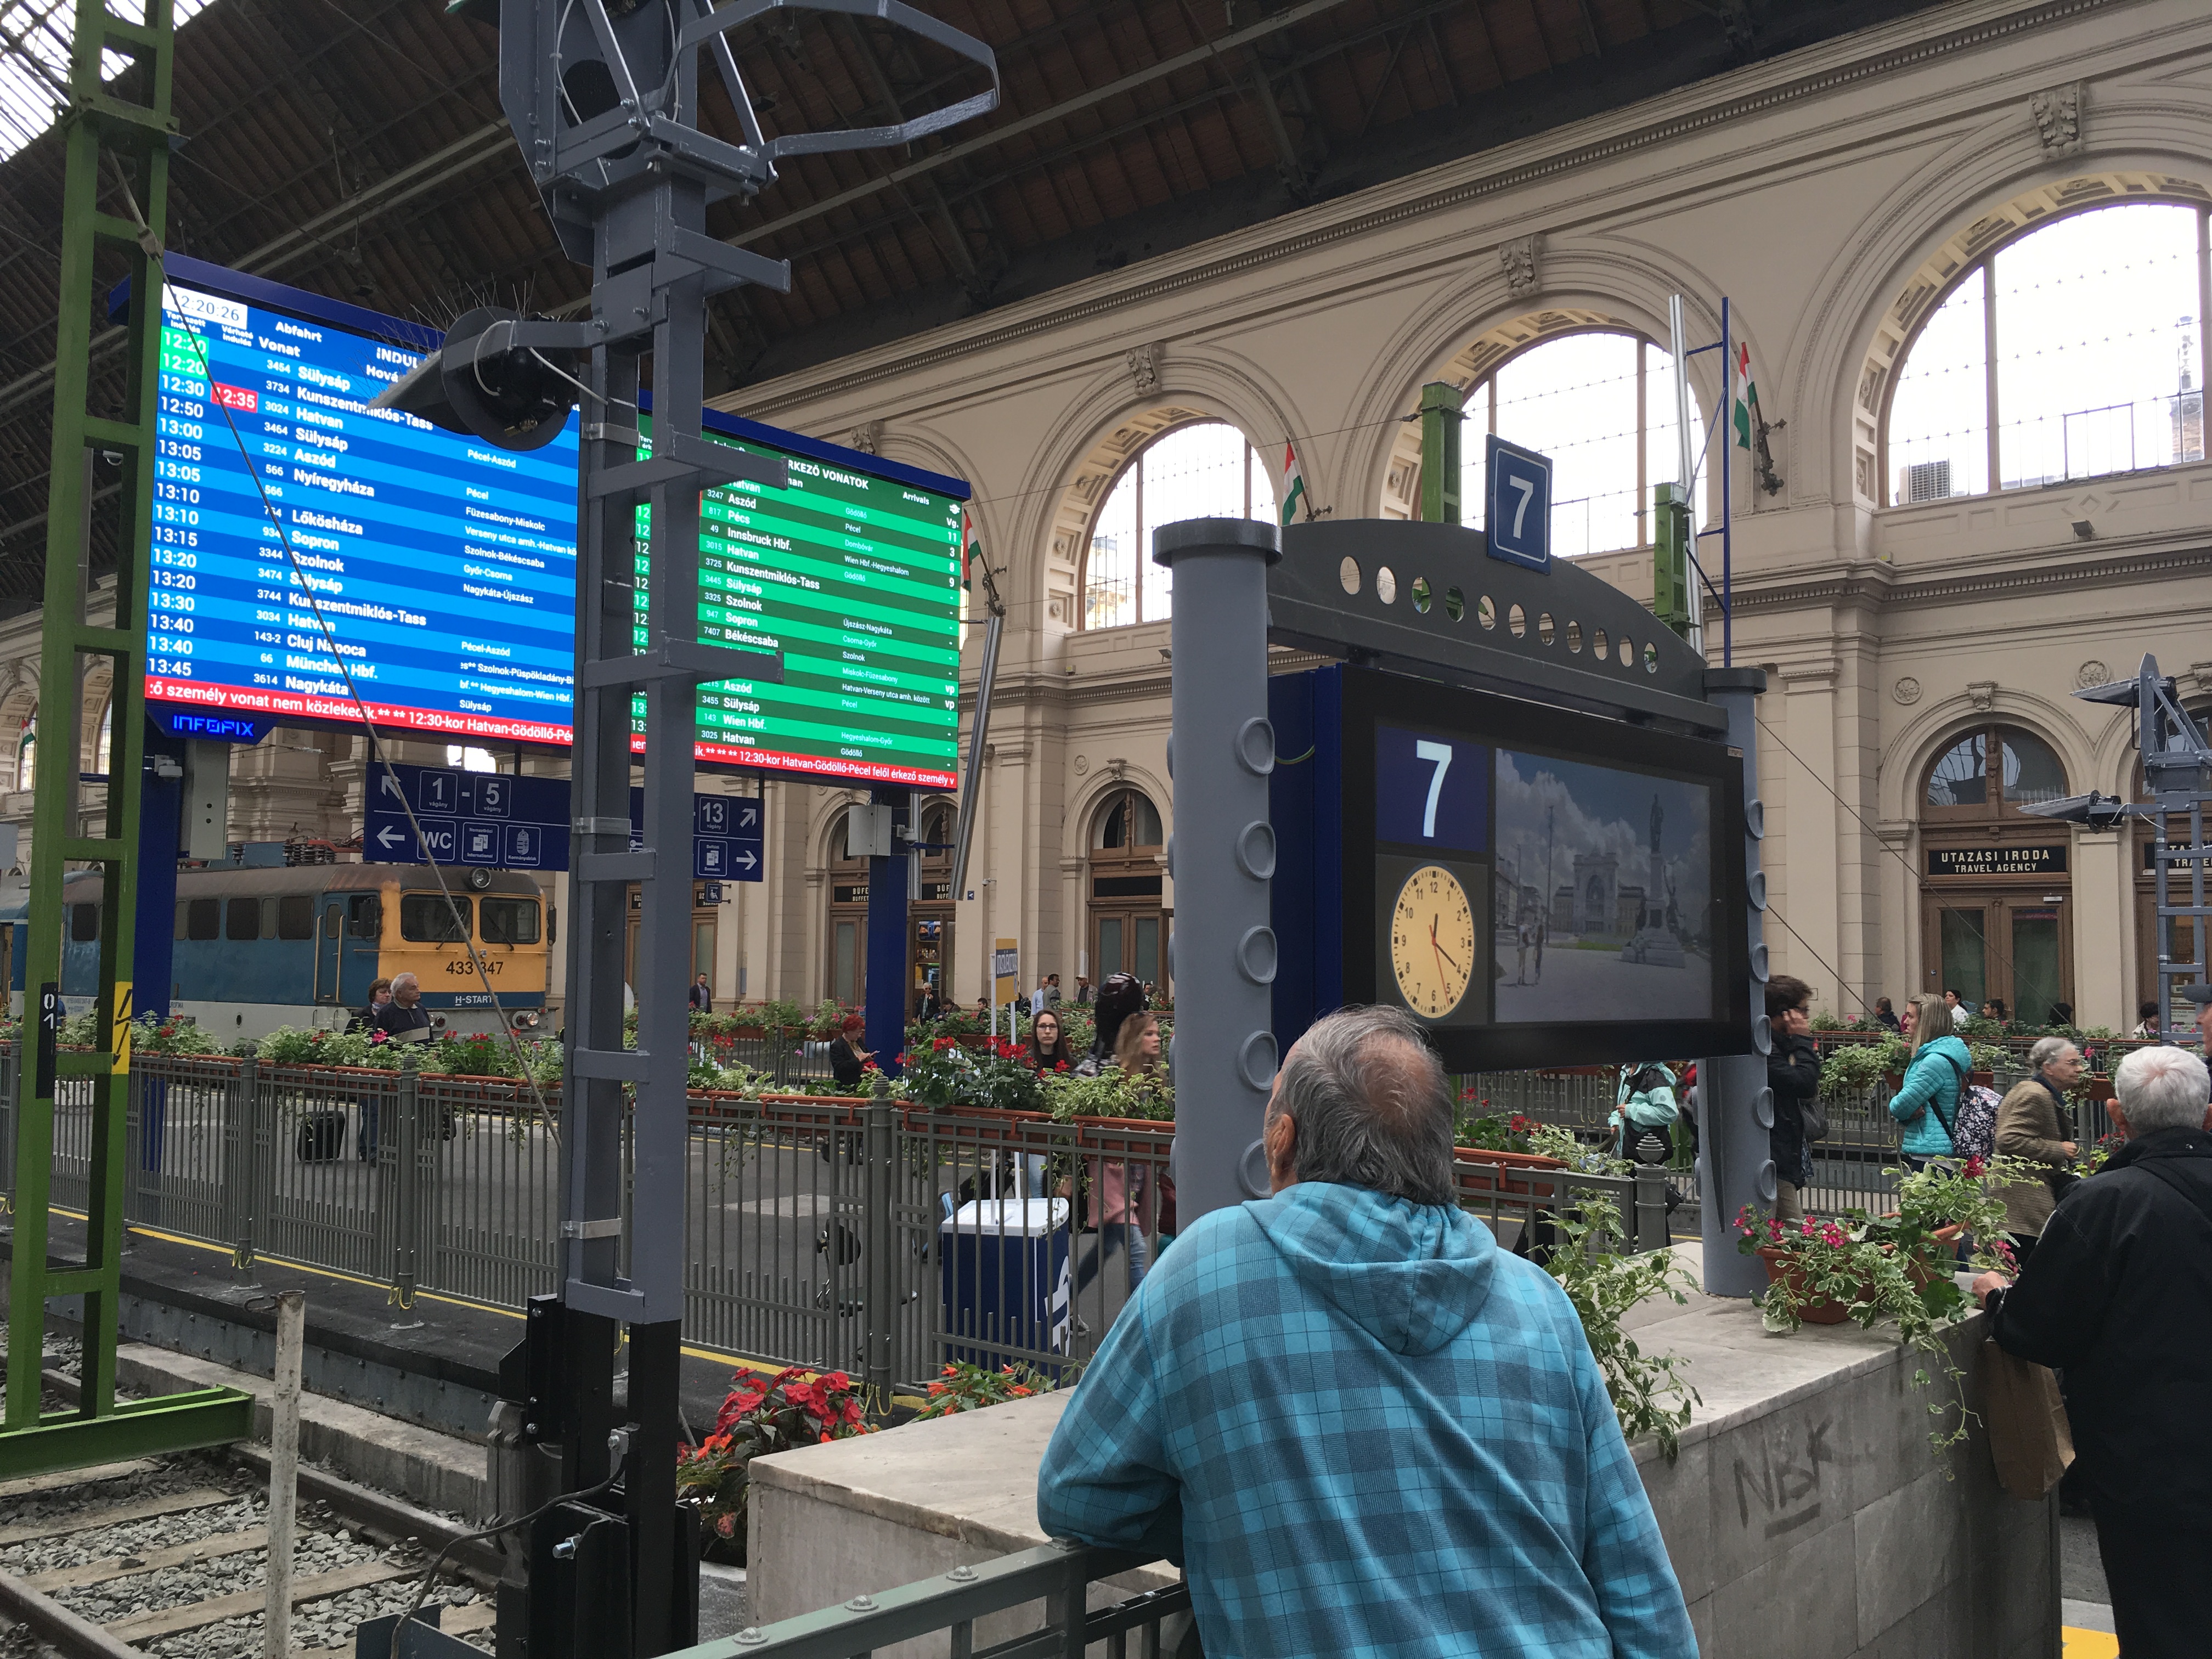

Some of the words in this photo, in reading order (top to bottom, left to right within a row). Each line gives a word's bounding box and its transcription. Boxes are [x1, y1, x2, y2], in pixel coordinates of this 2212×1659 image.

[223, 333, 251, 346] Indulás
[275, 321, 321, 342] Abfahrt
[258, 336, 300, 357] Vonat
[165, 332, 206, 354] 12:20
[267, 359, 290, 373] 3454
[298, 366, 350, 392] Sülysáp
[163, 353, 205, 375] 12:20
[266, 380, 289, 393] 3734
[366, 364, 398, 382] Hová
[162, 375, 204, 396] 12:30
[265, 401, 289, 414] 3024
[296, 407, 343, 429] Hatvan
[161, 396, 203, 417] 12:50
[264, 421, 287, 435] 3464
[295, 427, 348, 452] Sülysáp
[160, 417, 202, 439] 13:00
[263, 442, 287, 455] 3224
[294, 448, 335, 468] Aszód
[466, 487, 488, 499] Pécel
[159, 439, 201, 460] 13:05
[266, 464, 283, 476] 566
[294, 468, 374, 496] Nyíregyháza
[466, 506, 545, 531] Füzesabony-Miskolc
[822, 468, 868, 489] VONATOK
[158, 461, 200, 482] 13:05
[264, 484, 283, 496] 566
[465, 526, 497, 541] Verseny
[902, 491, 929, 505] Arrivals
[1510, 475, 1533, 539] 7
[156, 504, 198, 524] 13:10
[291, 530, 338, 550] Sopron
[157, 483, 199, 503] 13:10
[292, 509, 363, 535] Lőkösháza
[464, 545, 544, 568] Szolnok-Békéscsaba
[707, 489, 724, 499] 3247
[727, 493, 756, 509] Aszód
[845, 523, 861, 533] Pécel
[949, 546, 955, 557] 3
[946, 517, 958, 528] Vg.
[709, 506, 721, 515] 817
[727, 509, 750, 524] Pécs
[949, 562, 955, 572] 8
[947, 531, 956, 542] 11
[706, 540, 722, 550] 3015
[726, 544, 759, 560] Hatvan
[710, 524, 719, 533] 49
[727, 527, 771, 546] Innsbruck
[772, 537, 792, 551] Hbf.
[844, 555, 859, 565] Wien
[949, 577, 954, 587] 9
[154, 548, 196, 567] 13:20
[258, 568, 281, 580] 3474
[155, 526, 197, 546] 13:15
[259, 547, 283, 559] 3344
[291, 551, 344, 572] Szolnok
[463, 583, 533, 603] Nagykáta-Újszász
[705, 557, 721, 568] 3725
[726, 560, 820, 589] Kunszentmiklós-Tass
[153, 570, 195, 589] 13:20
[257, 589, 281, 601] 3744
[705, 574, 721, 584] 3445
[726, 578, 762, 596] Sülysáp
[152, 592, 194, 611] 13:30
[256, 610, 280, 622] 3034
[704, 592, 721, 602] 3325
[725, 594, 762, 611] Szolnok
[706, 610, 718, 618] 947
[725, 612, 758, 627] Sopron
[151, 614, 193, 632] 13:40
[255, 631, 280, 643] 143-2
[287, 634, 313, 652] Cluj
[703, 626, 720, 636] 7407
[724, 628, 778, 647] Békéscsaba
[842, 651, 865, 661] Szolnok
[150, 636, 192, 654] 13:40
[261, 653, 273, 663] 66
[351, 663, 377, 678] Hbf.
[149, 658, 191, 676] 13:45
[253, 673, 278, 684] 3614
[285, 675, 348, 695] Nagykáta
[459, 699, 492, 713] Sülysáp
[723, 680, 752, 693] Aszód
[945, 685, 955, 695] vp
[702, 695, 718, 704] 3455
[723, 697, 759, 714] Sülysáp
[842, 683, 885, 698] Hatvan-Verseny
[944, 699, 955, 710] vp
[166, 686, 227, 704] személy
[230, 693, 269, 707] vonat
[273, 698, 302, 710] nem
[409, 712, 465, 729] 12:30-kor
[704, 713, 716, 721] 143
[723, 714, 746, 726] Wien
[747, 717, 766, 729] Hbf.
[701, 730, 718, 739] 3025
[722, 731, 755, 745] Hatvan
[740, 751, 781, 764] 12:30-kor
[782, 756, 870, 775] Hatvan-Gödöllő-Pécel
[872, 766, 889, 777] felől
[891, 769, 916, 780] érkező
[918, 774, 948, 786] személy
[432, 777, 443, 800] 1
[486, 783, 500, 805] 5
[1417, 740, 1452, 838] 7
[703, 802, 724, 823] 13
[422, 831, 452, 849] WC
[1941, 850, 1998, 863] UTAZÁSI
[2005, 849, 2050, 861] IRODA
[1955, 864, 1993, 873] TRAVEL
[1996, 862, 2037, 872] AGENCY
[1416, 888, 1423, 900] 11
[1447, 890, 1450, 901] 1
[1430, 882, 1438, 893] 12
[1405, 907, 1413, 919] 10
[1457, 910, 1462, 922] 2
[1402, 935, 1406, 946] 9
[1460, 937, 1465, 949] 3
[446, 961, 473, 975] 433
[480, 961, 504, 975] 347
[1406, 962, 1410, 974] 8
[1457, 964, 1462, 975] 4
[1417, 983, 1421, 994] 7
[1446, 983, 1451, 994] 5
[1431, 990, 1436, 1002] 6
